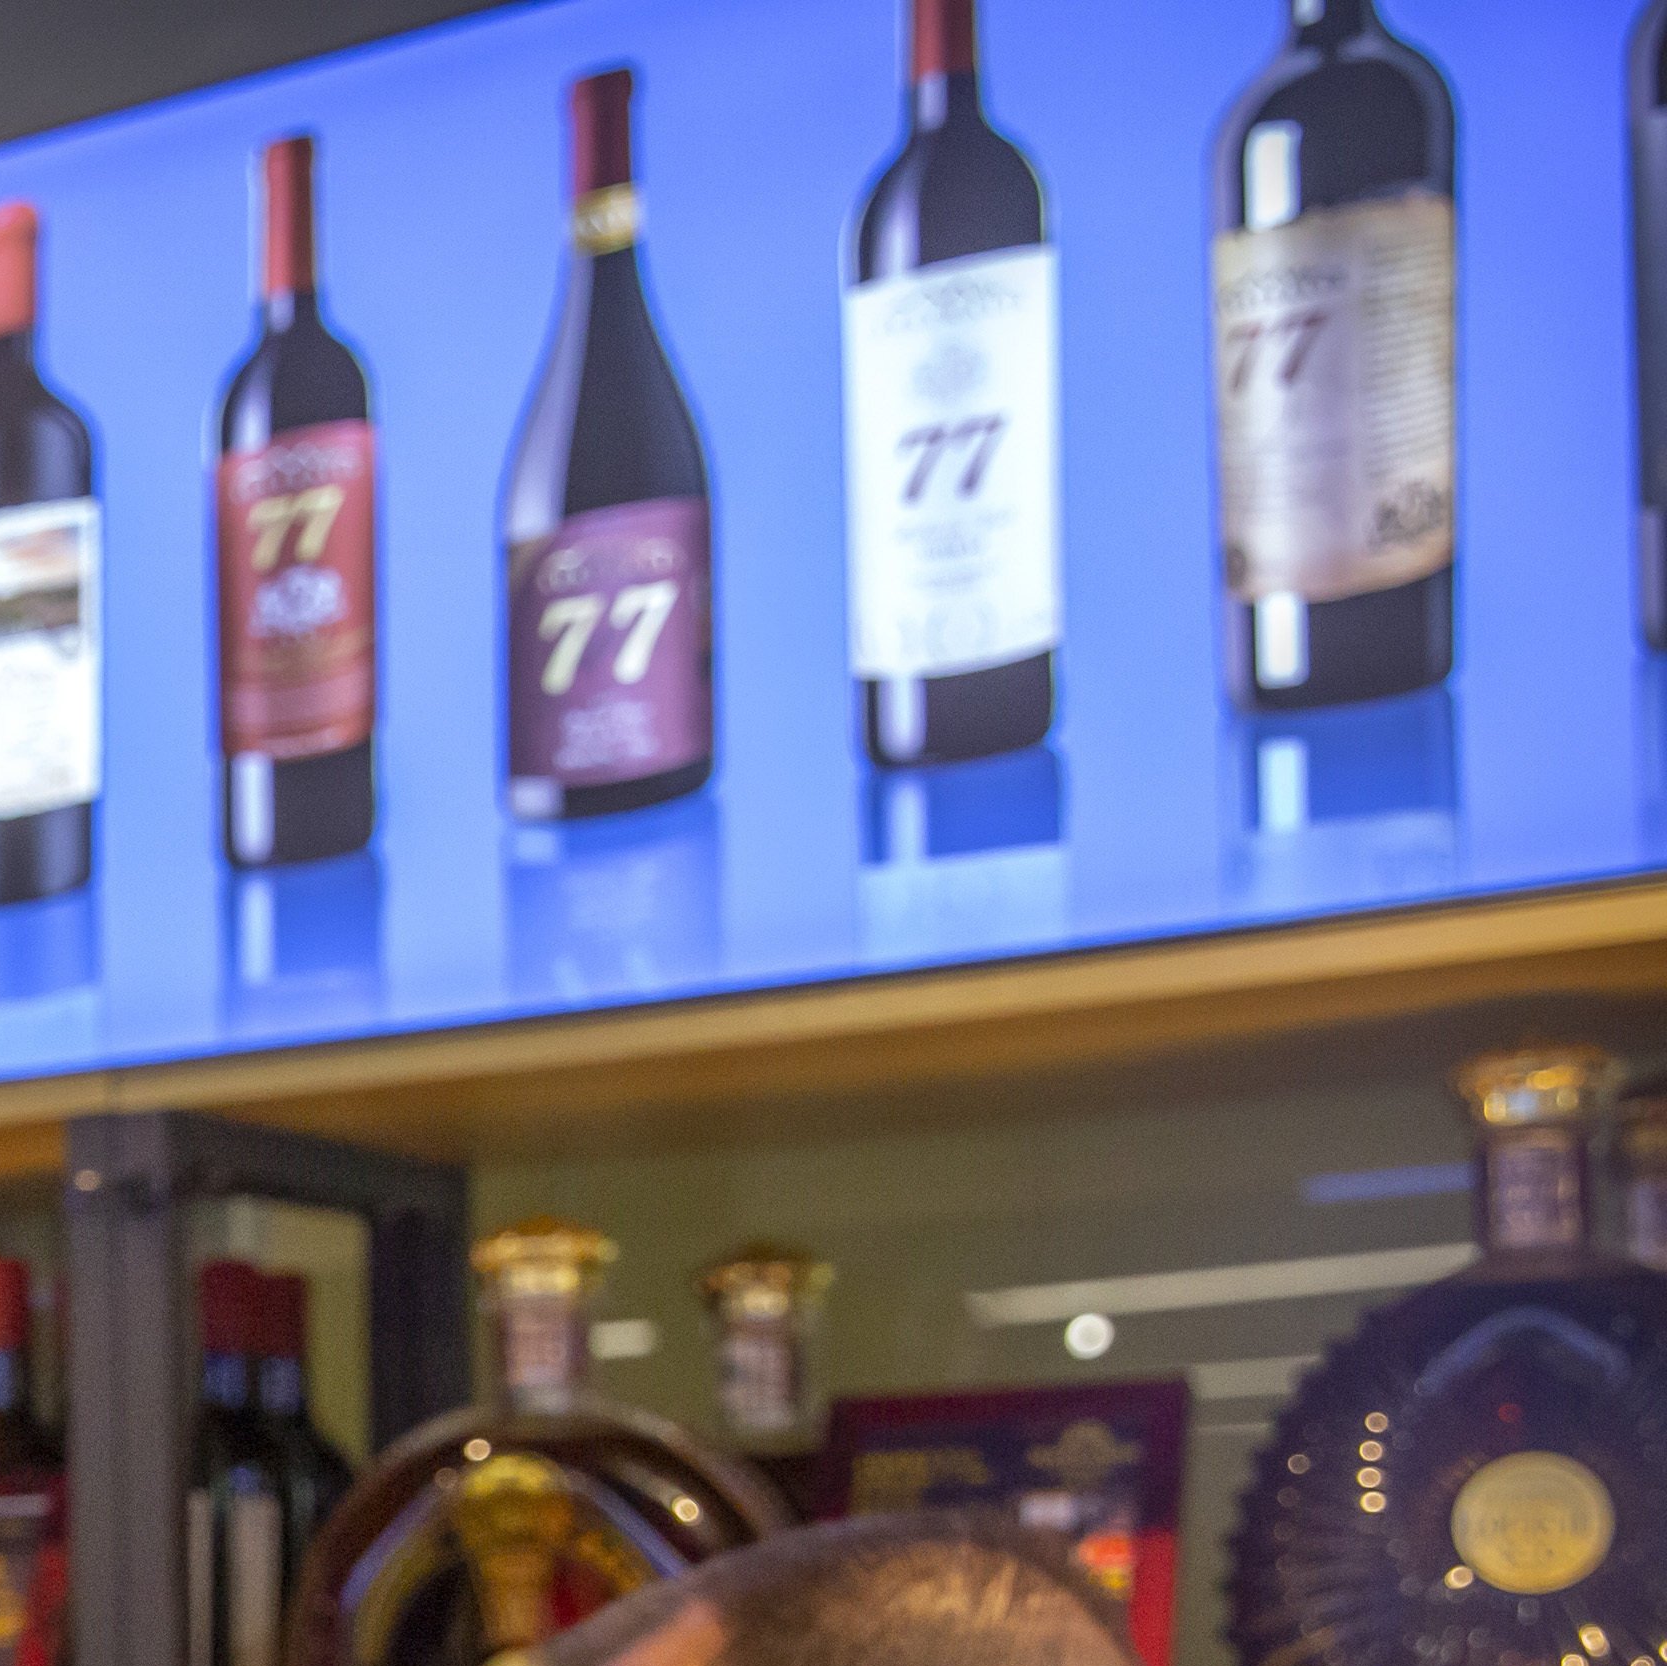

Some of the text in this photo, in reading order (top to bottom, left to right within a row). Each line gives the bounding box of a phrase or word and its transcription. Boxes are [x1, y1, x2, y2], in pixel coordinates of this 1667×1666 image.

[1225, 312, 1329, 393] 77
[895, 410, 1010, 508] 77
[246, 483, 344, 572] 77
[538, 578, 679, 696] 77
